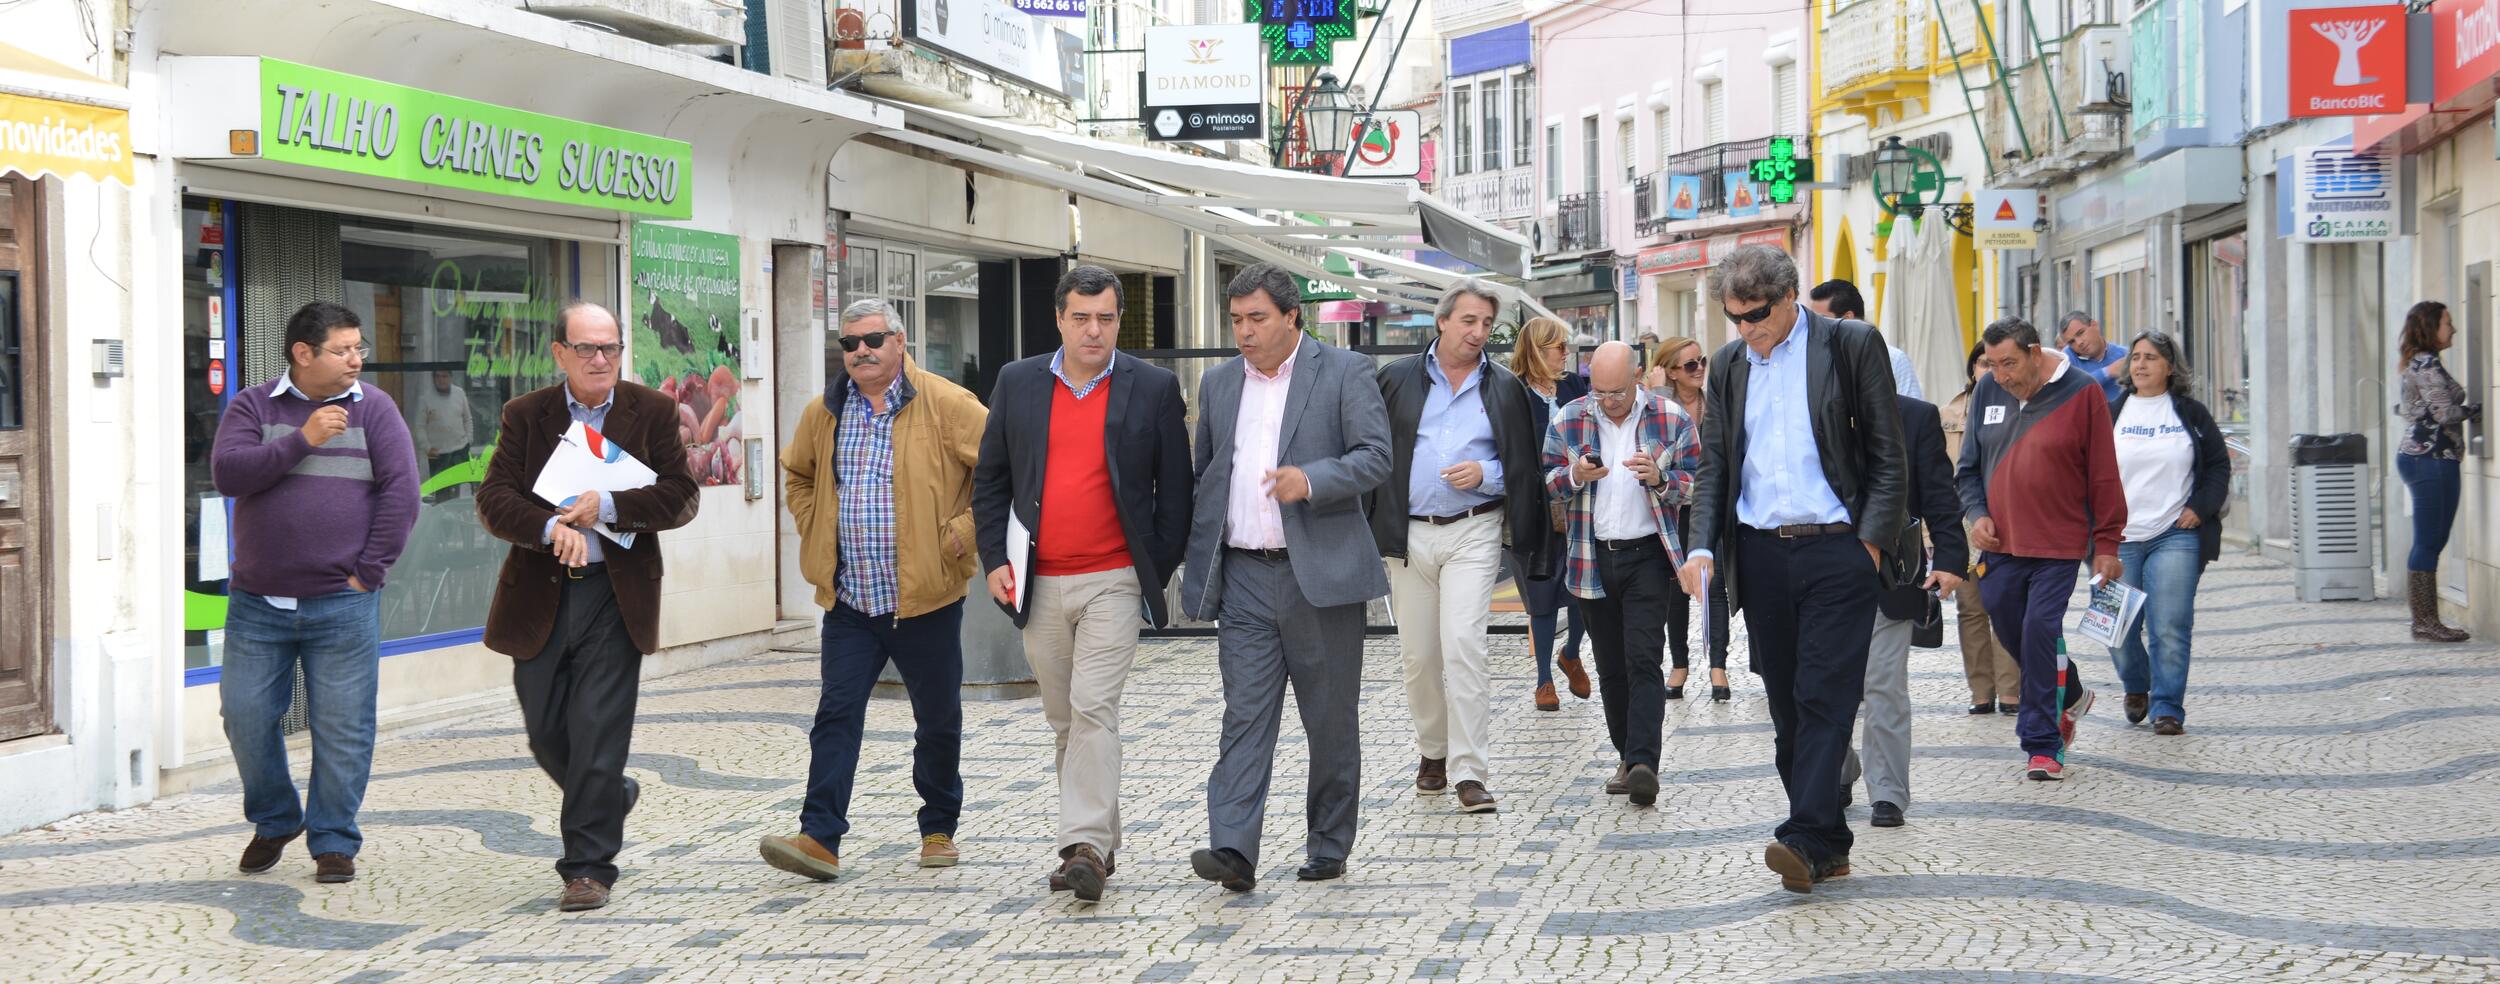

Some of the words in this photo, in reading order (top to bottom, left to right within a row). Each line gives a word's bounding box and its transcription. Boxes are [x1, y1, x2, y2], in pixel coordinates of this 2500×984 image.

[1017, 0, 1031, 8] 93
[1033, 0, 1054, 10] 662
[1056, 0, 1070, 11] 66
[1072, 0, 1085, 12] 16
[993, 12, 1027, 50] mimosa
[1157, 75, 1252, 91] DIAMOND
[2309, 93, 2385, 110] BancoBIC
[1206, 113, 1255, 125] mimosa
[0, 116, 121, 162] novidades
[277, 84, 399, 159] TALHO
[420, 113, 544, 184] CARNES
[559, 140, 680, 204] SUCESSO
[2306, 200, 2391, 213] MULTIBANCO
[2334, 220, 2386, 228] CAIXA
[2334, 227, 2388, 237] automático
[663, 232, 697, 262] conhecer
[706, 247, 730, 266] nossa
[638, 261, 682, 292] variedade
[683, 263, 693, 294] de
[695, 268, 738, 308] preparados
[1307, 279, 1342, 293] CASA
[2159, 424, 2185, 434] Team
